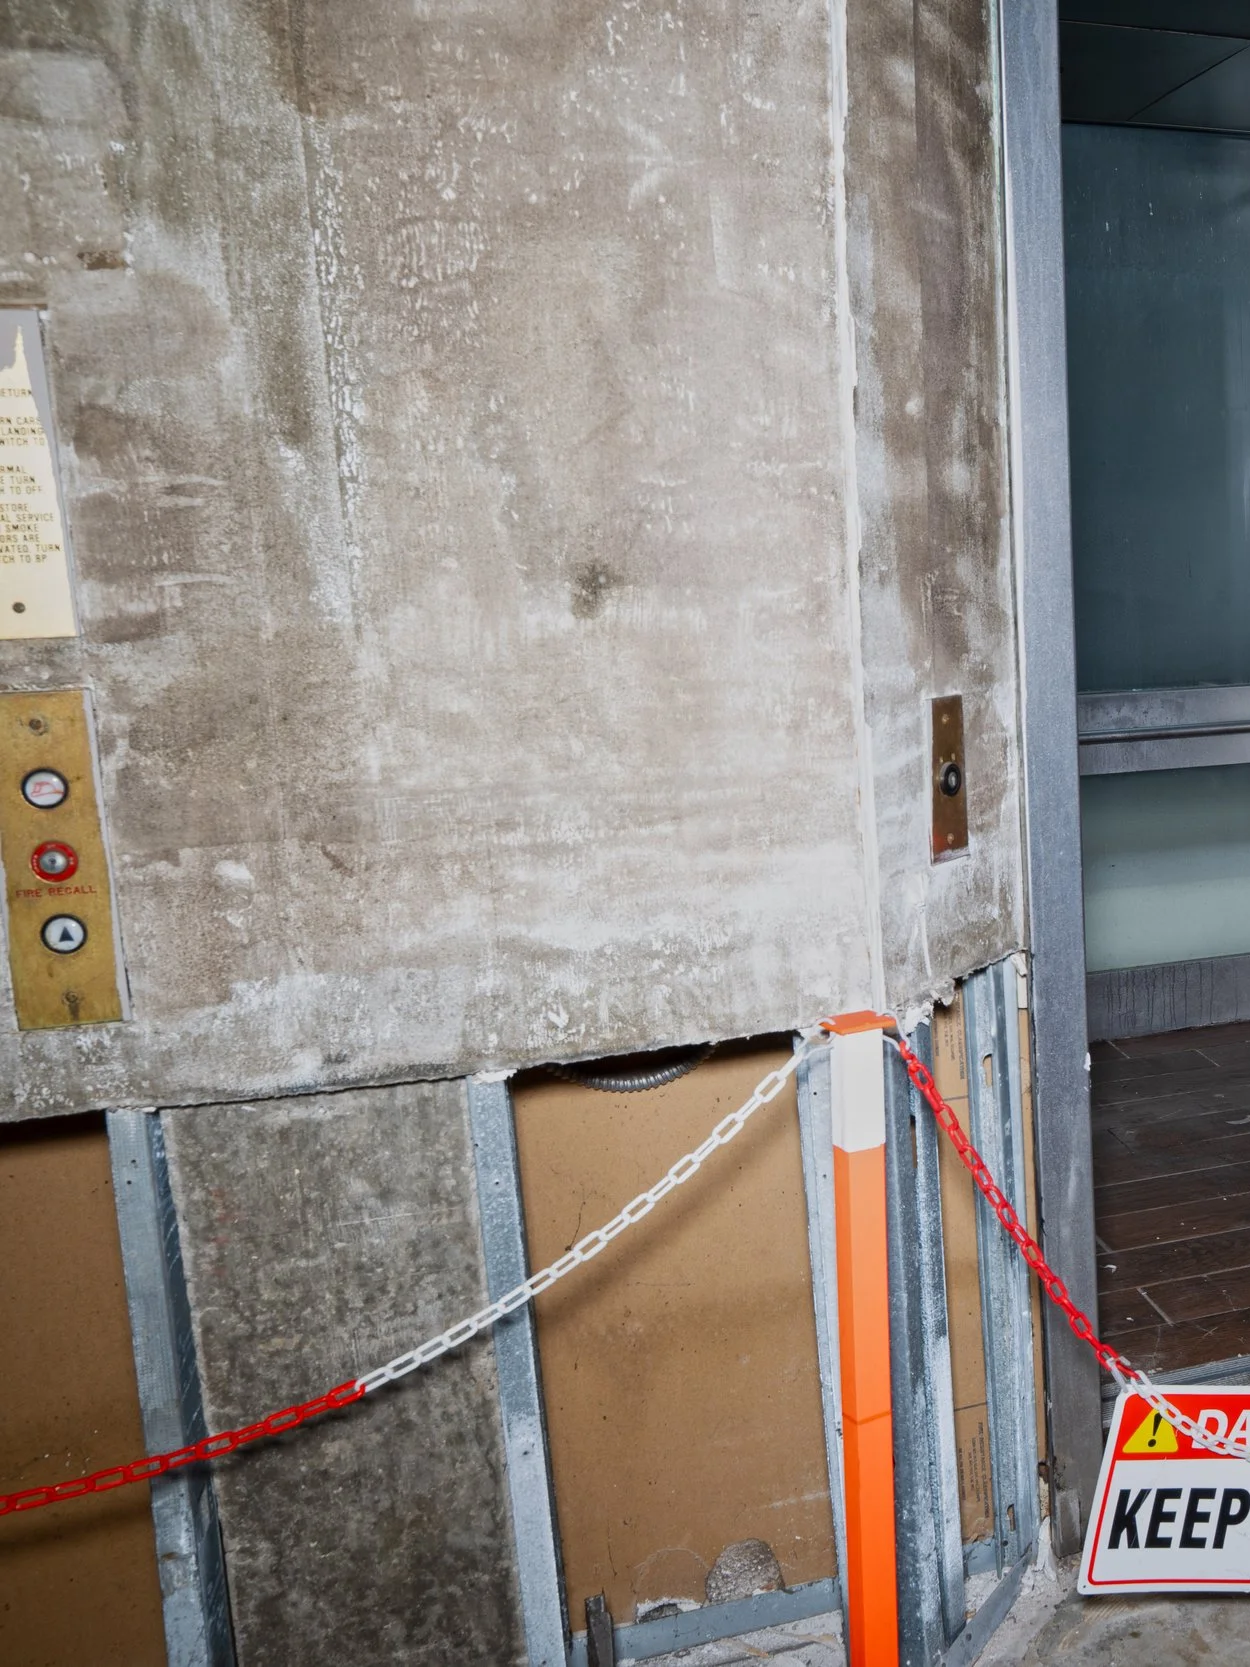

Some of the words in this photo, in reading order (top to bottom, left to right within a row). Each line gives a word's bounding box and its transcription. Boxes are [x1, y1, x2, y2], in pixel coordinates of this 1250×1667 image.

[10, 475, 36, 485] TURN
[9, 486, 21, 495] TO
[15, 513, 54, 522] SERVICE
[5, 523, 40, 533] SMOKE
[23, 533, 41, 543] ARE
[35, 543, 61, 553] TURN
[15, 888, 42, 898] FIRE
[47, 885, 97, 897] RECALL
